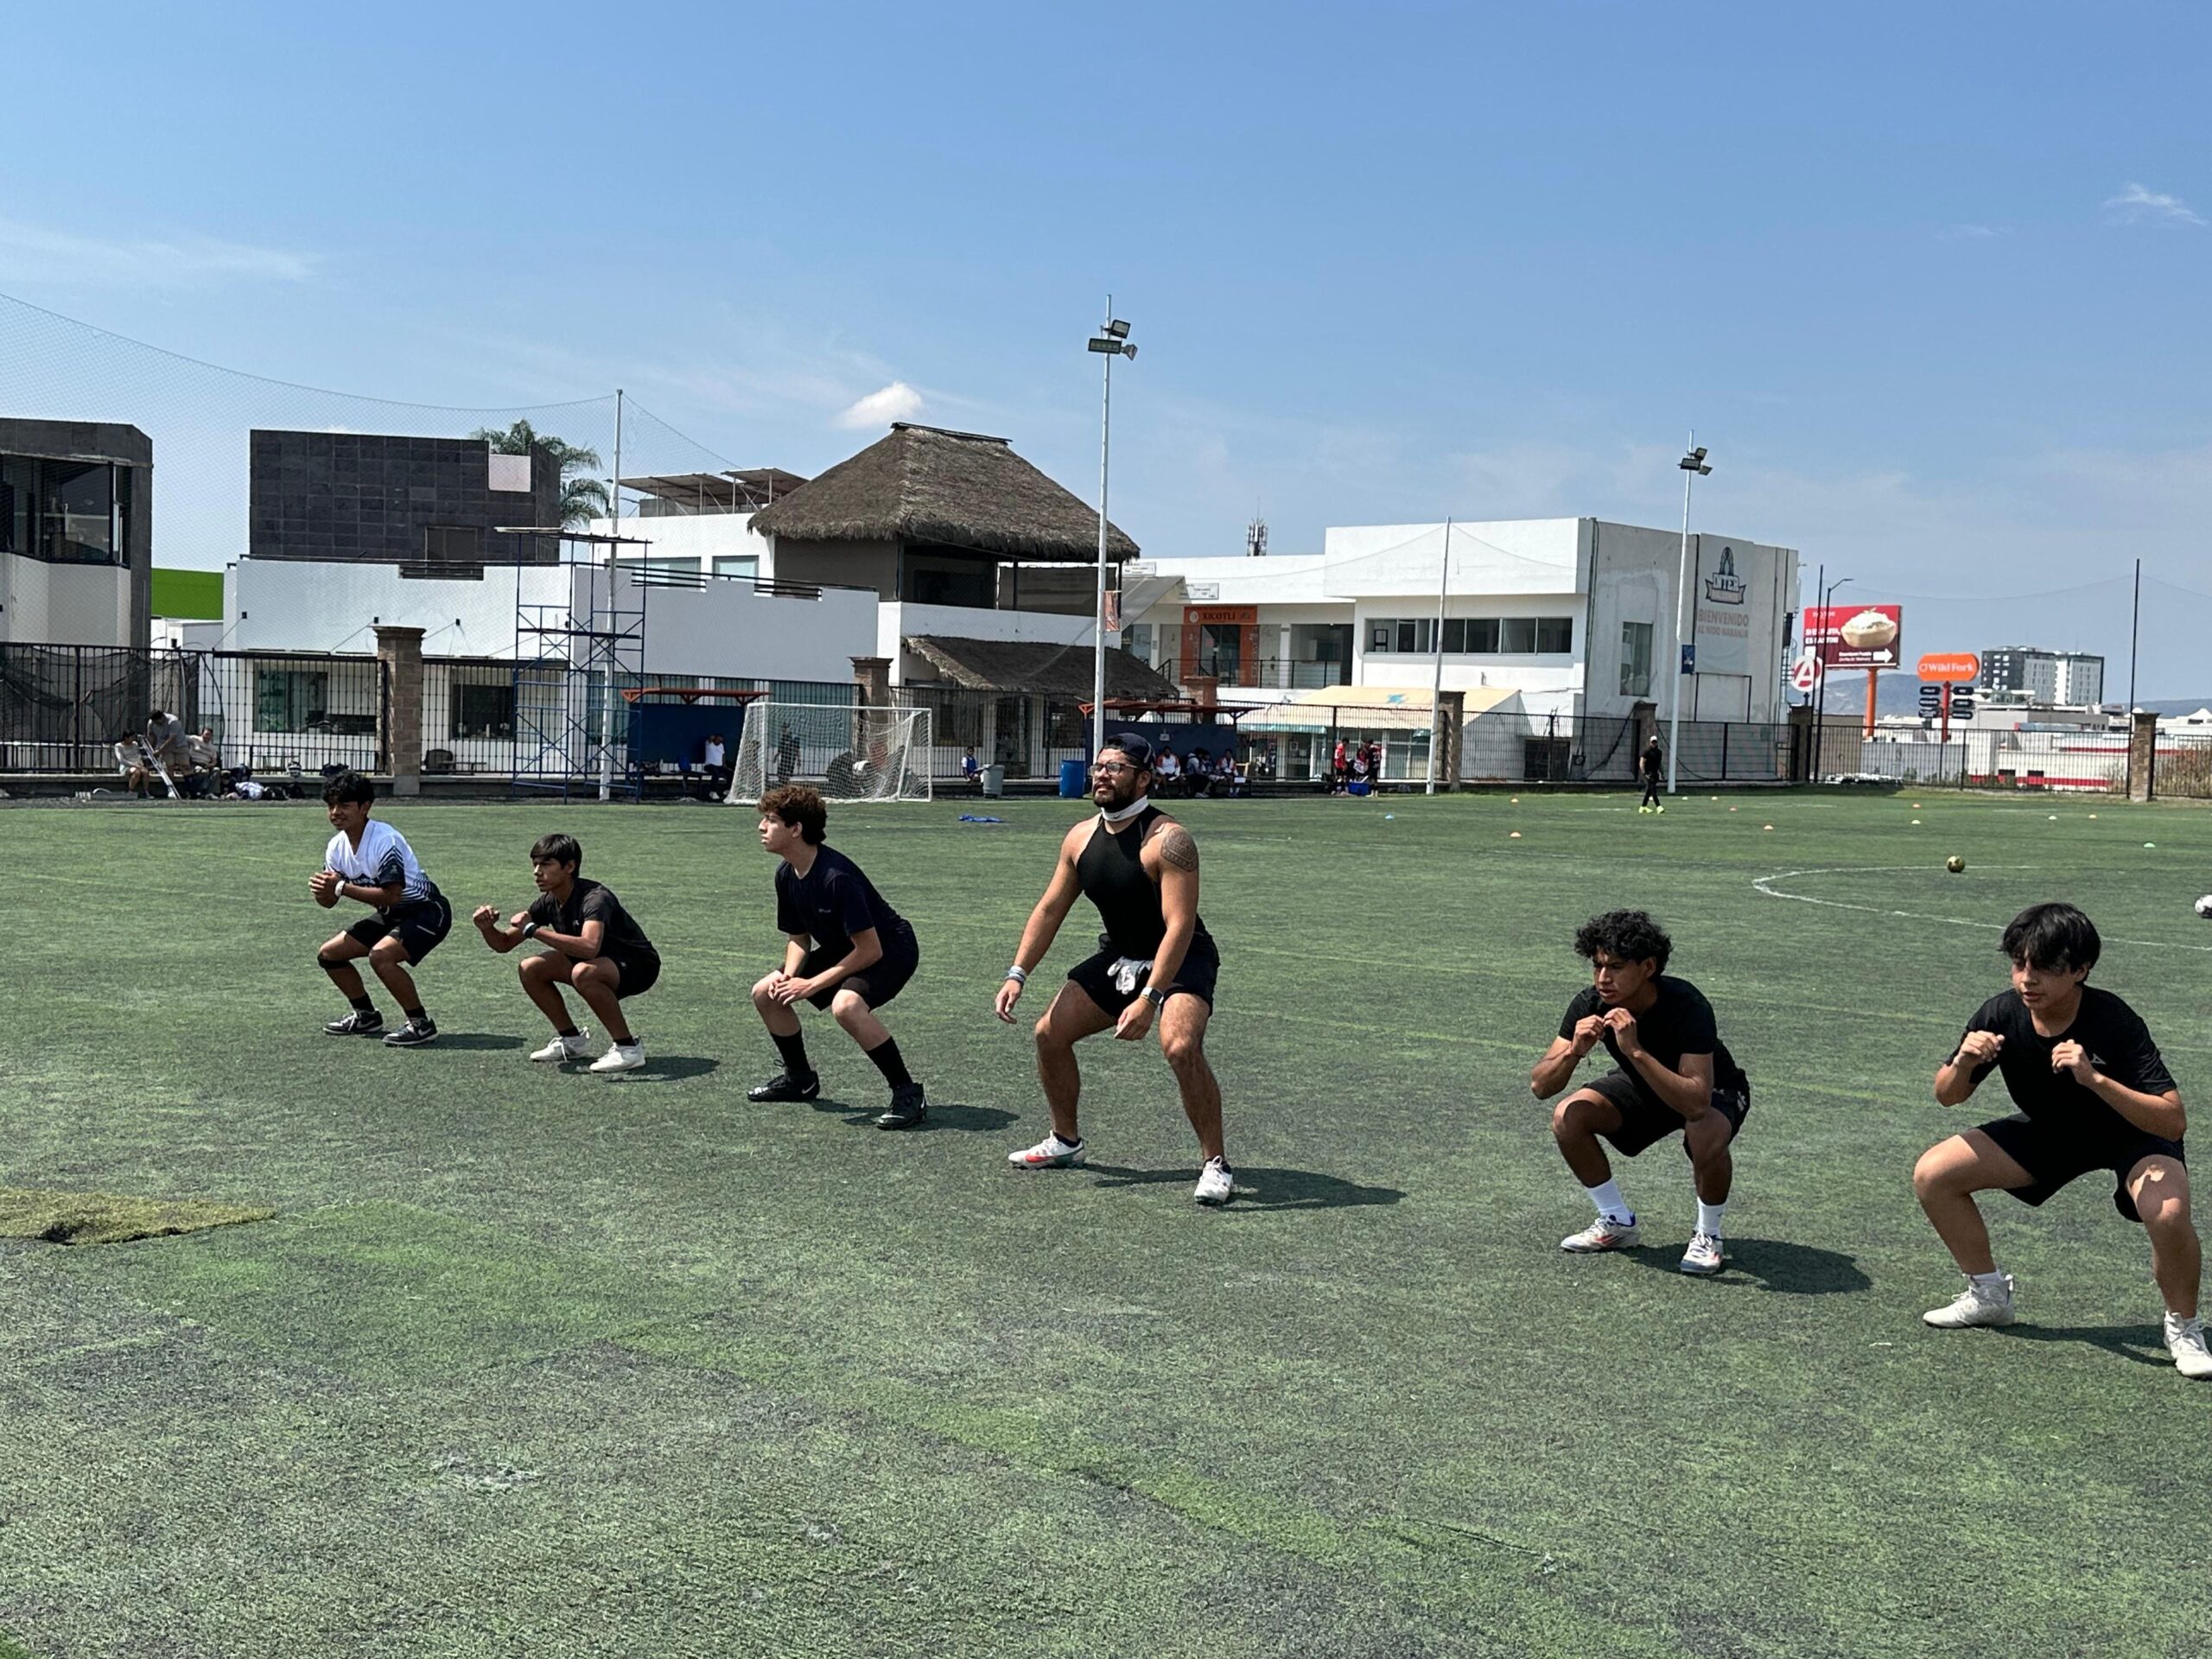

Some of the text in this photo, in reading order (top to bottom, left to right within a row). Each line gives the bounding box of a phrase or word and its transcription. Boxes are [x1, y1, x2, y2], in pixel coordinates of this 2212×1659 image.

[1202, 612, 1236, 620] XICOTLI
[1699, 608, 1750, 627] BIENVENIDO
[1928, 663, 1974, 672] Wild Fork
